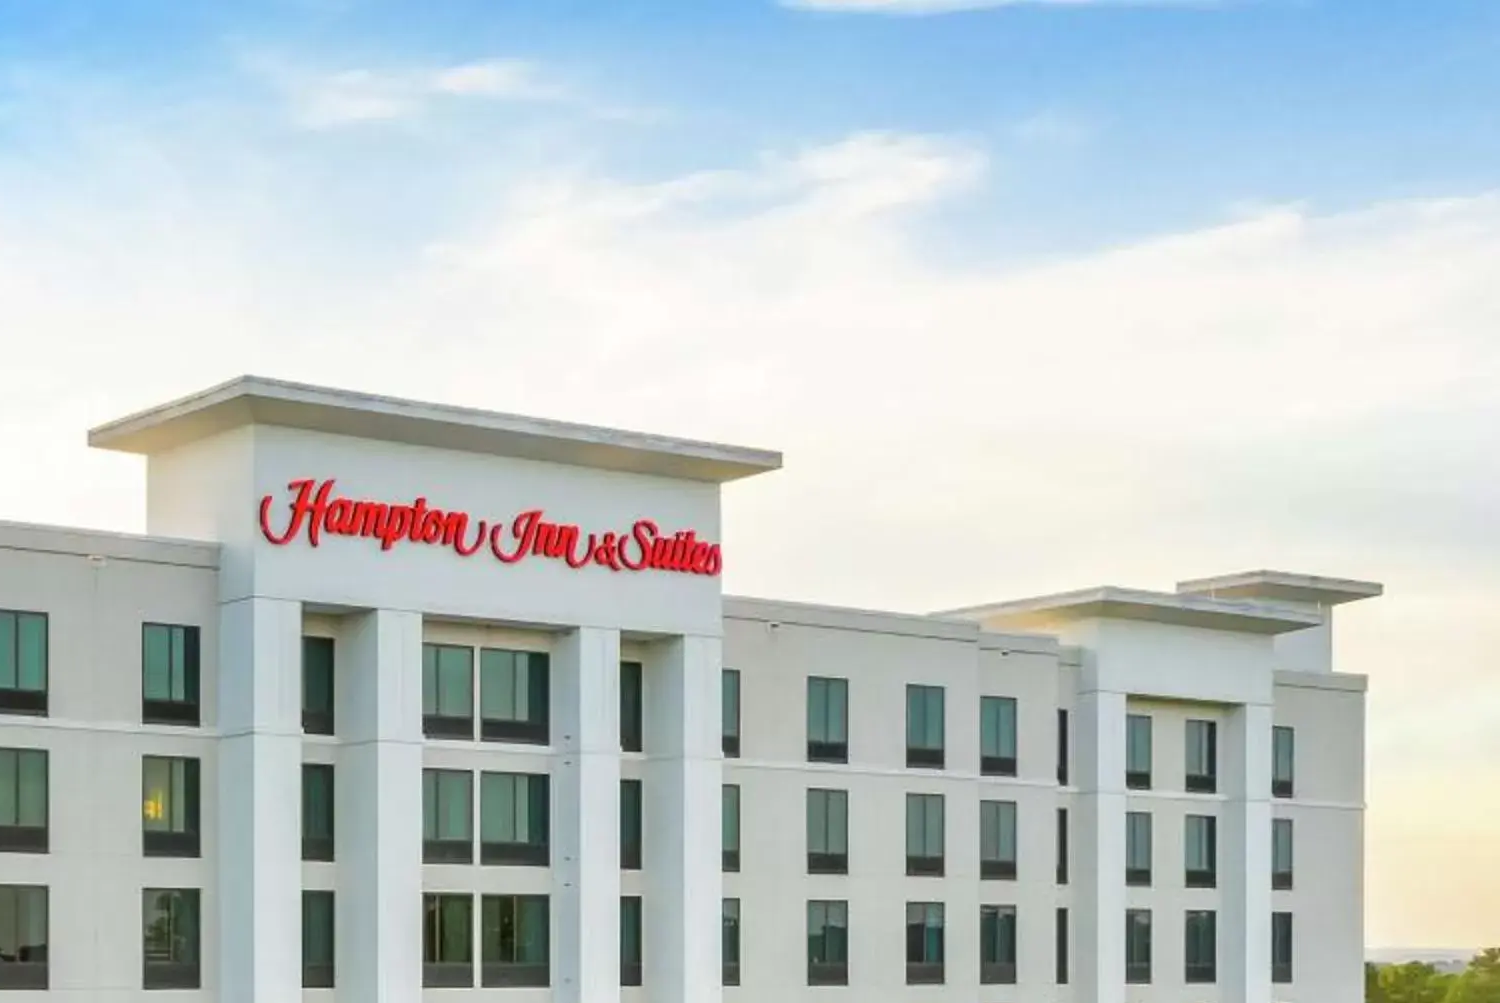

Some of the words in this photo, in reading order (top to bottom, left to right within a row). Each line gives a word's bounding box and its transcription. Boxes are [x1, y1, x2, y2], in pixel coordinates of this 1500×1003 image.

[259, 479, 486, 556] Hampton
[491, 510, 596, 568] Inn
[618, 520, 722, 576] Suites
